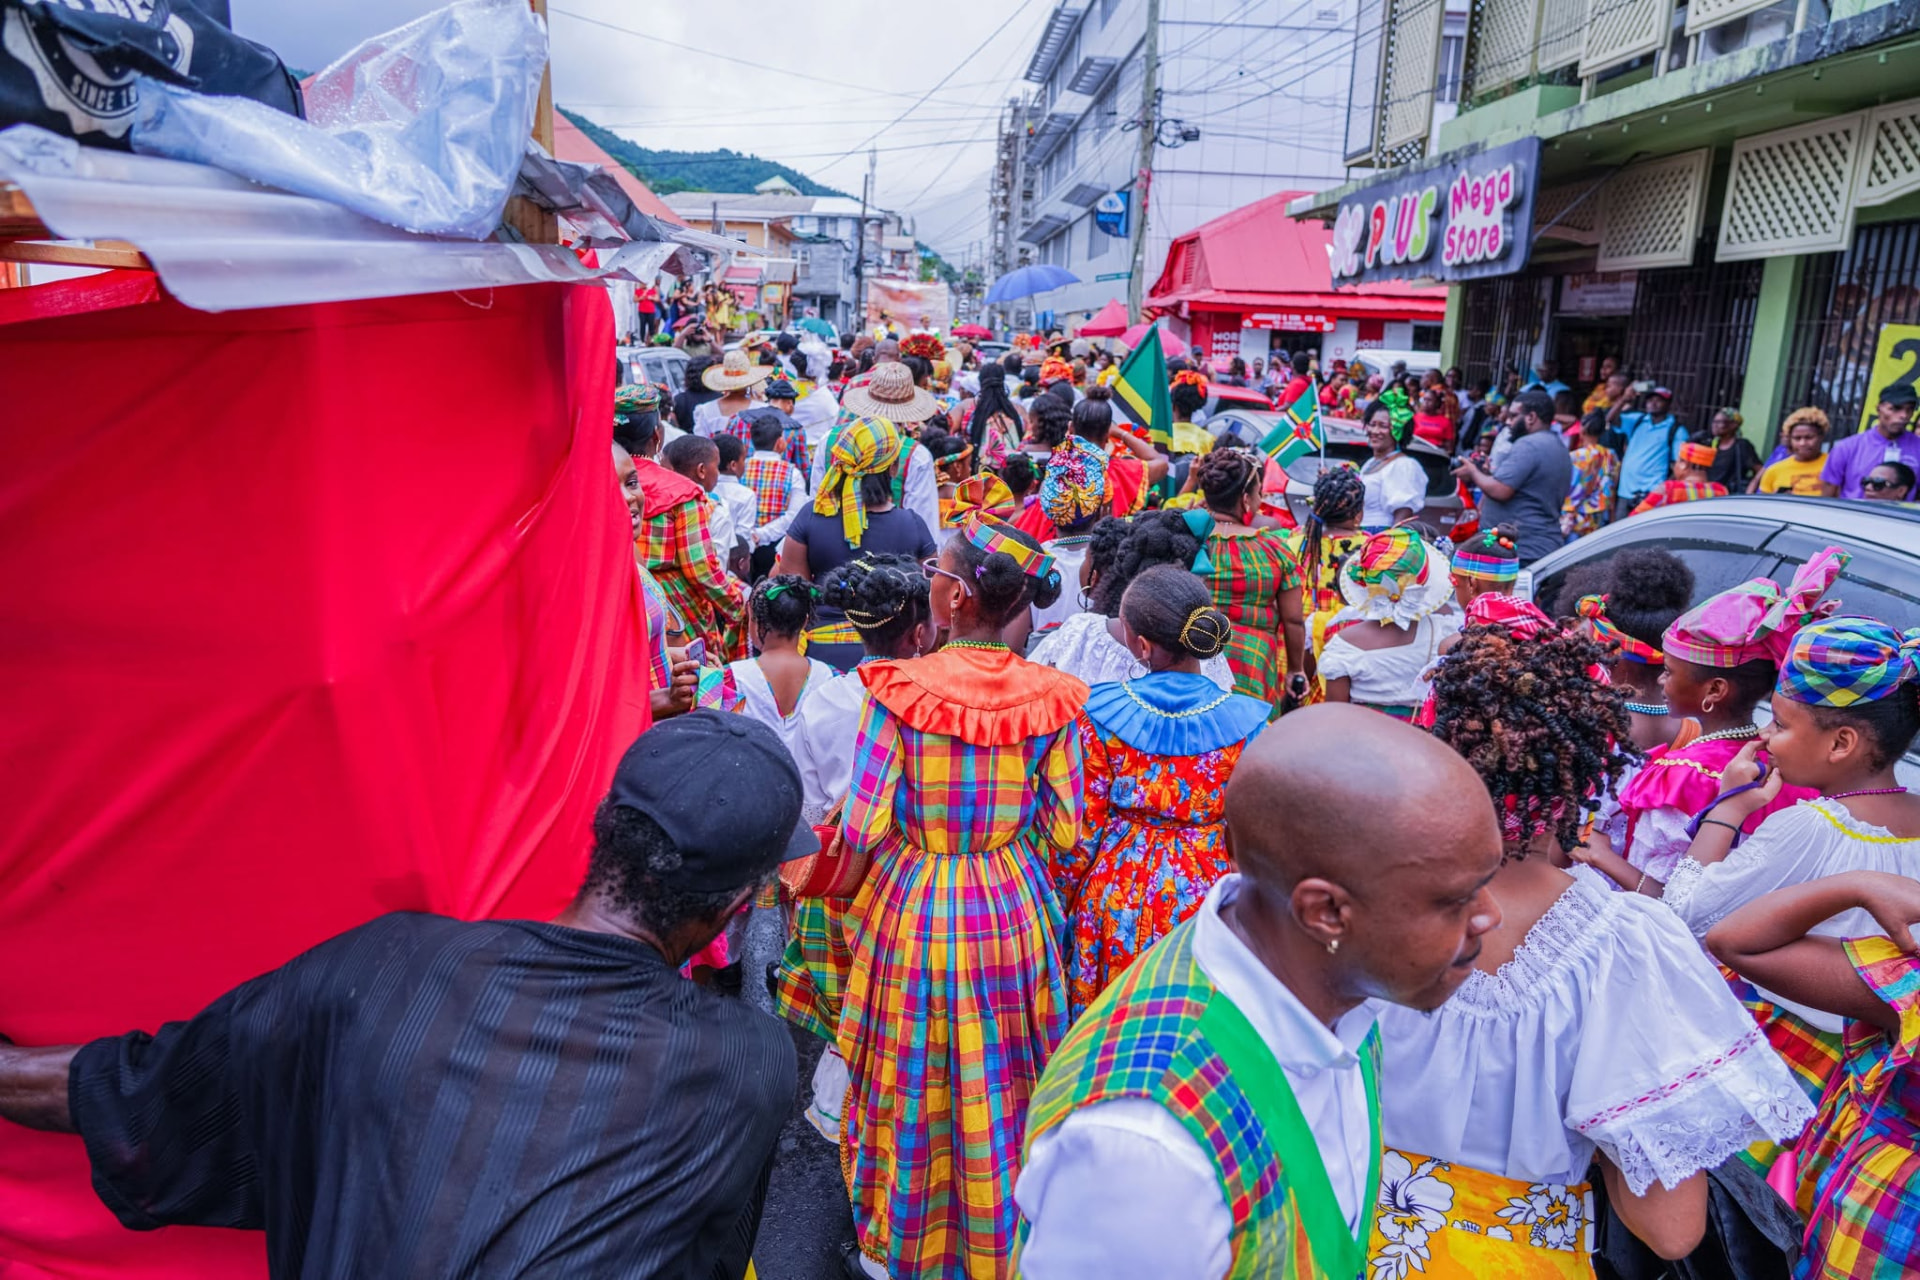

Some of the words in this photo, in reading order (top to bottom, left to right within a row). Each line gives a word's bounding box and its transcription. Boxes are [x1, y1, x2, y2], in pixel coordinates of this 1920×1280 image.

[69, 73, 116, 111] SINCE
[1450, 168, 1512, 219] Mega
[1366, 188, 1437, 267] PLUS
[1443, 222, 1501, 262] Store
